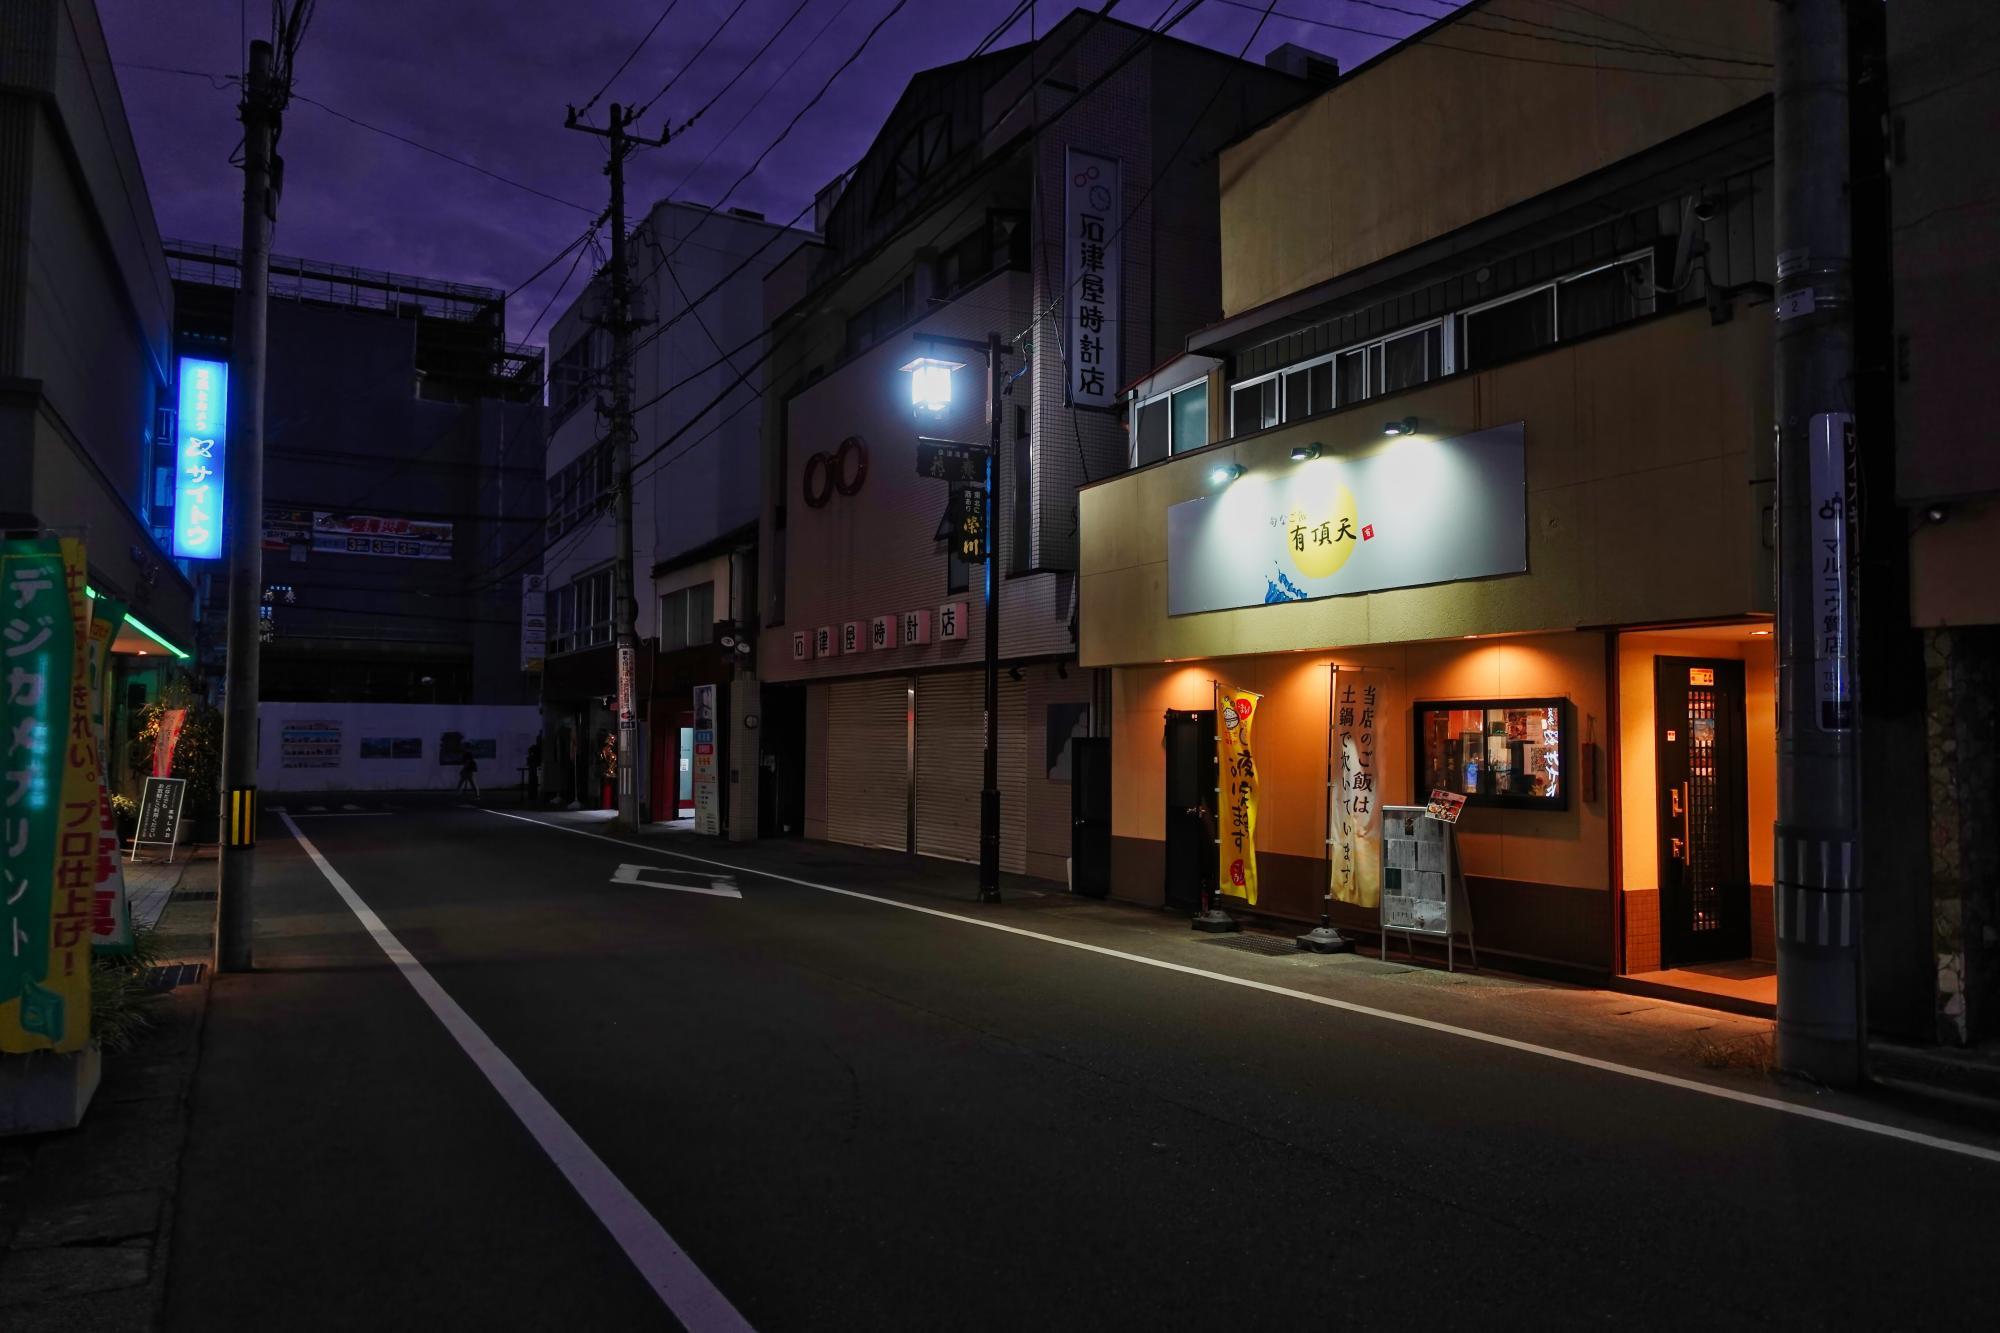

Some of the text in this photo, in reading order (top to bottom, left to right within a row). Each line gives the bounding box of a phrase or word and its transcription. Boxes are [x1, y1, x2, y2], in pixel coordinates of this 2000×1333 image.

[1080, 212, 1106, 397] 石津屋時計店
[1791, 300, 1800, 313] 2
[1290, 517, 1357, 552] 有頂天
[794, 608, 956, 659] 石津屋時計店
[1338, 684, 1356, 885] 土鍋で炊いています
[1352, 686, 1377, 815] 当店のご飯は
